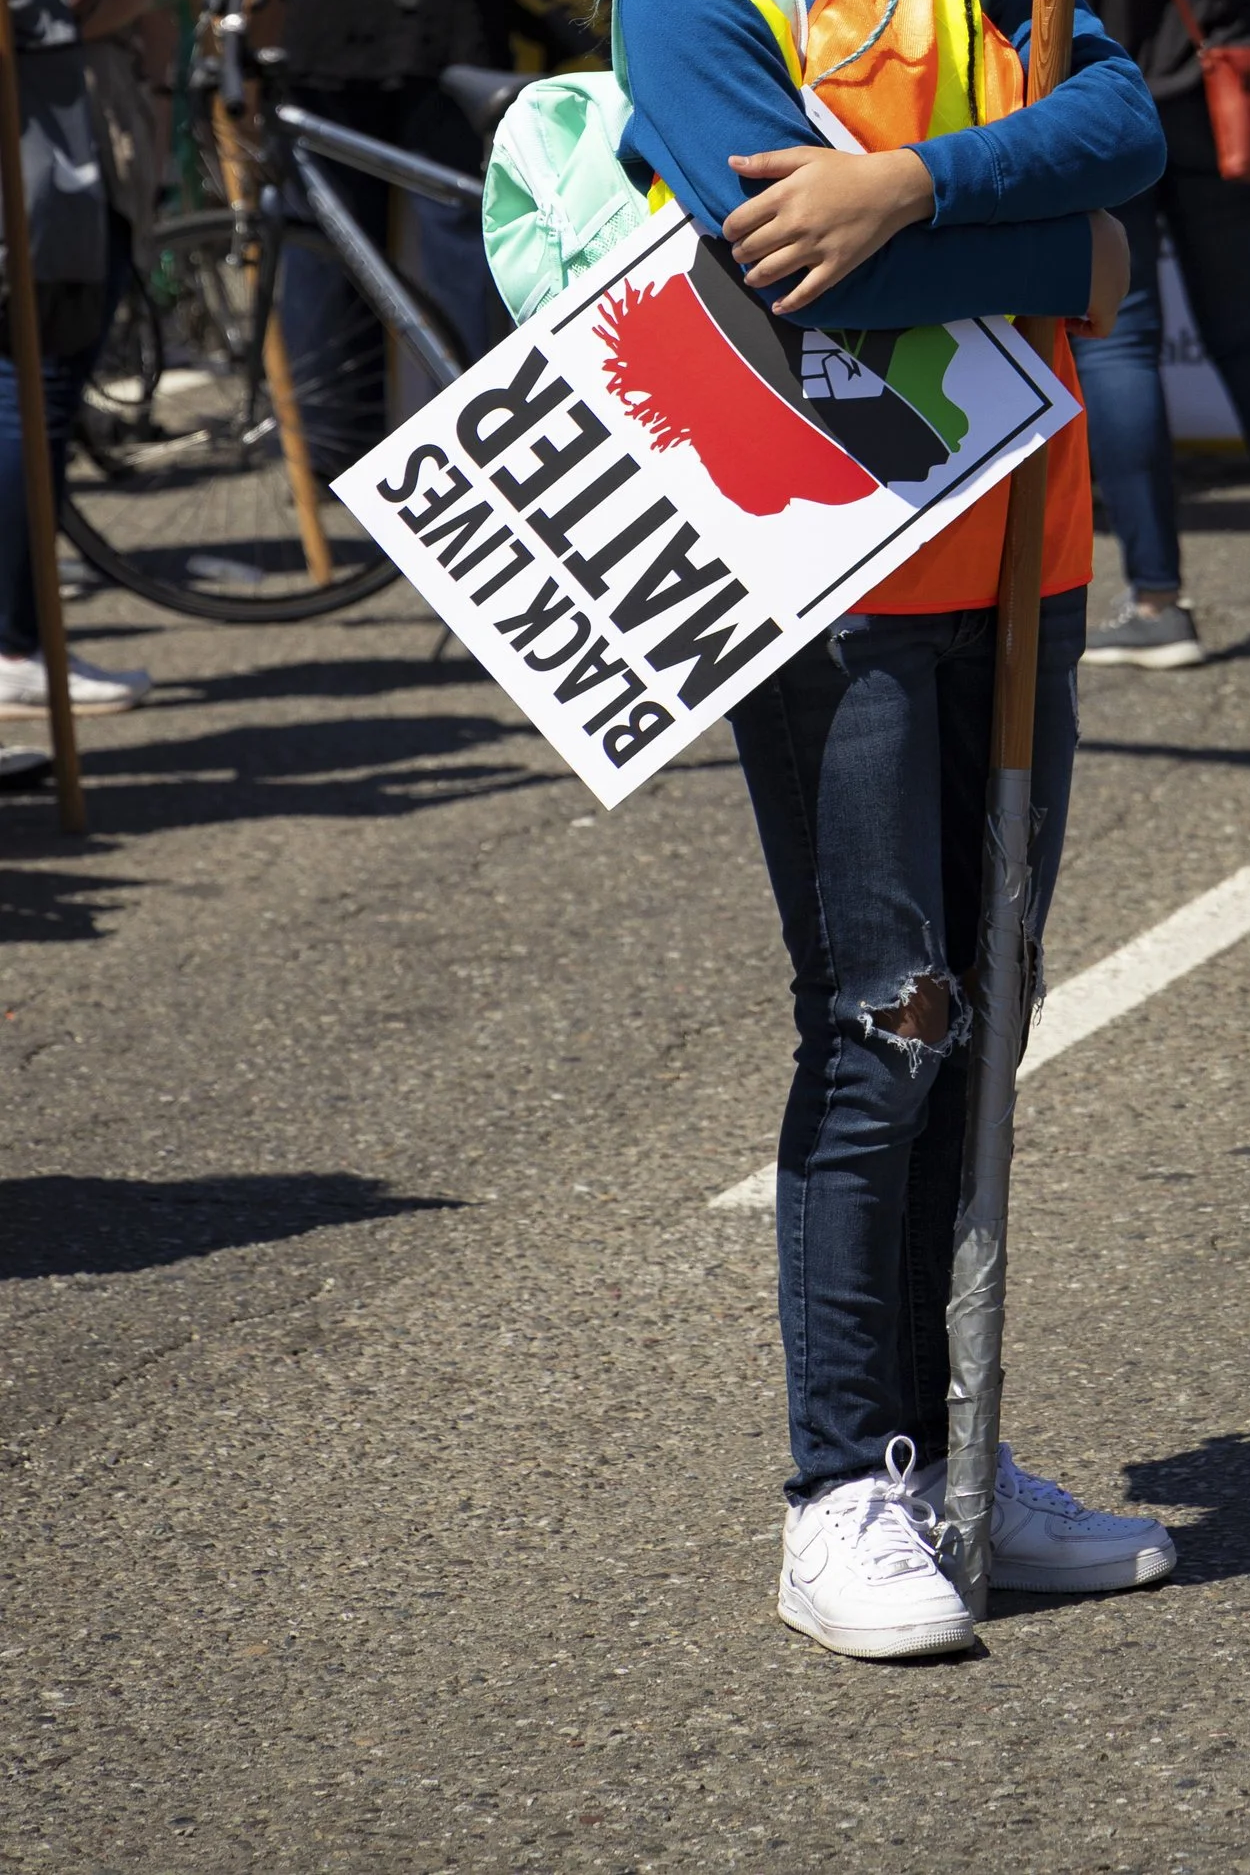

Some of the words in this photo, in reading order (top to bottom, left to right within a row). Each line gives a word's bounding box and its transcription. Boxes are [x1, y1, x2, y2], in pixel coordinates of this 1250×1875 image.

[375, 443, 536, 607] LIVES
[455, 345, 784, 712] MATTER
[493, 575, 676, 769] BLACK
